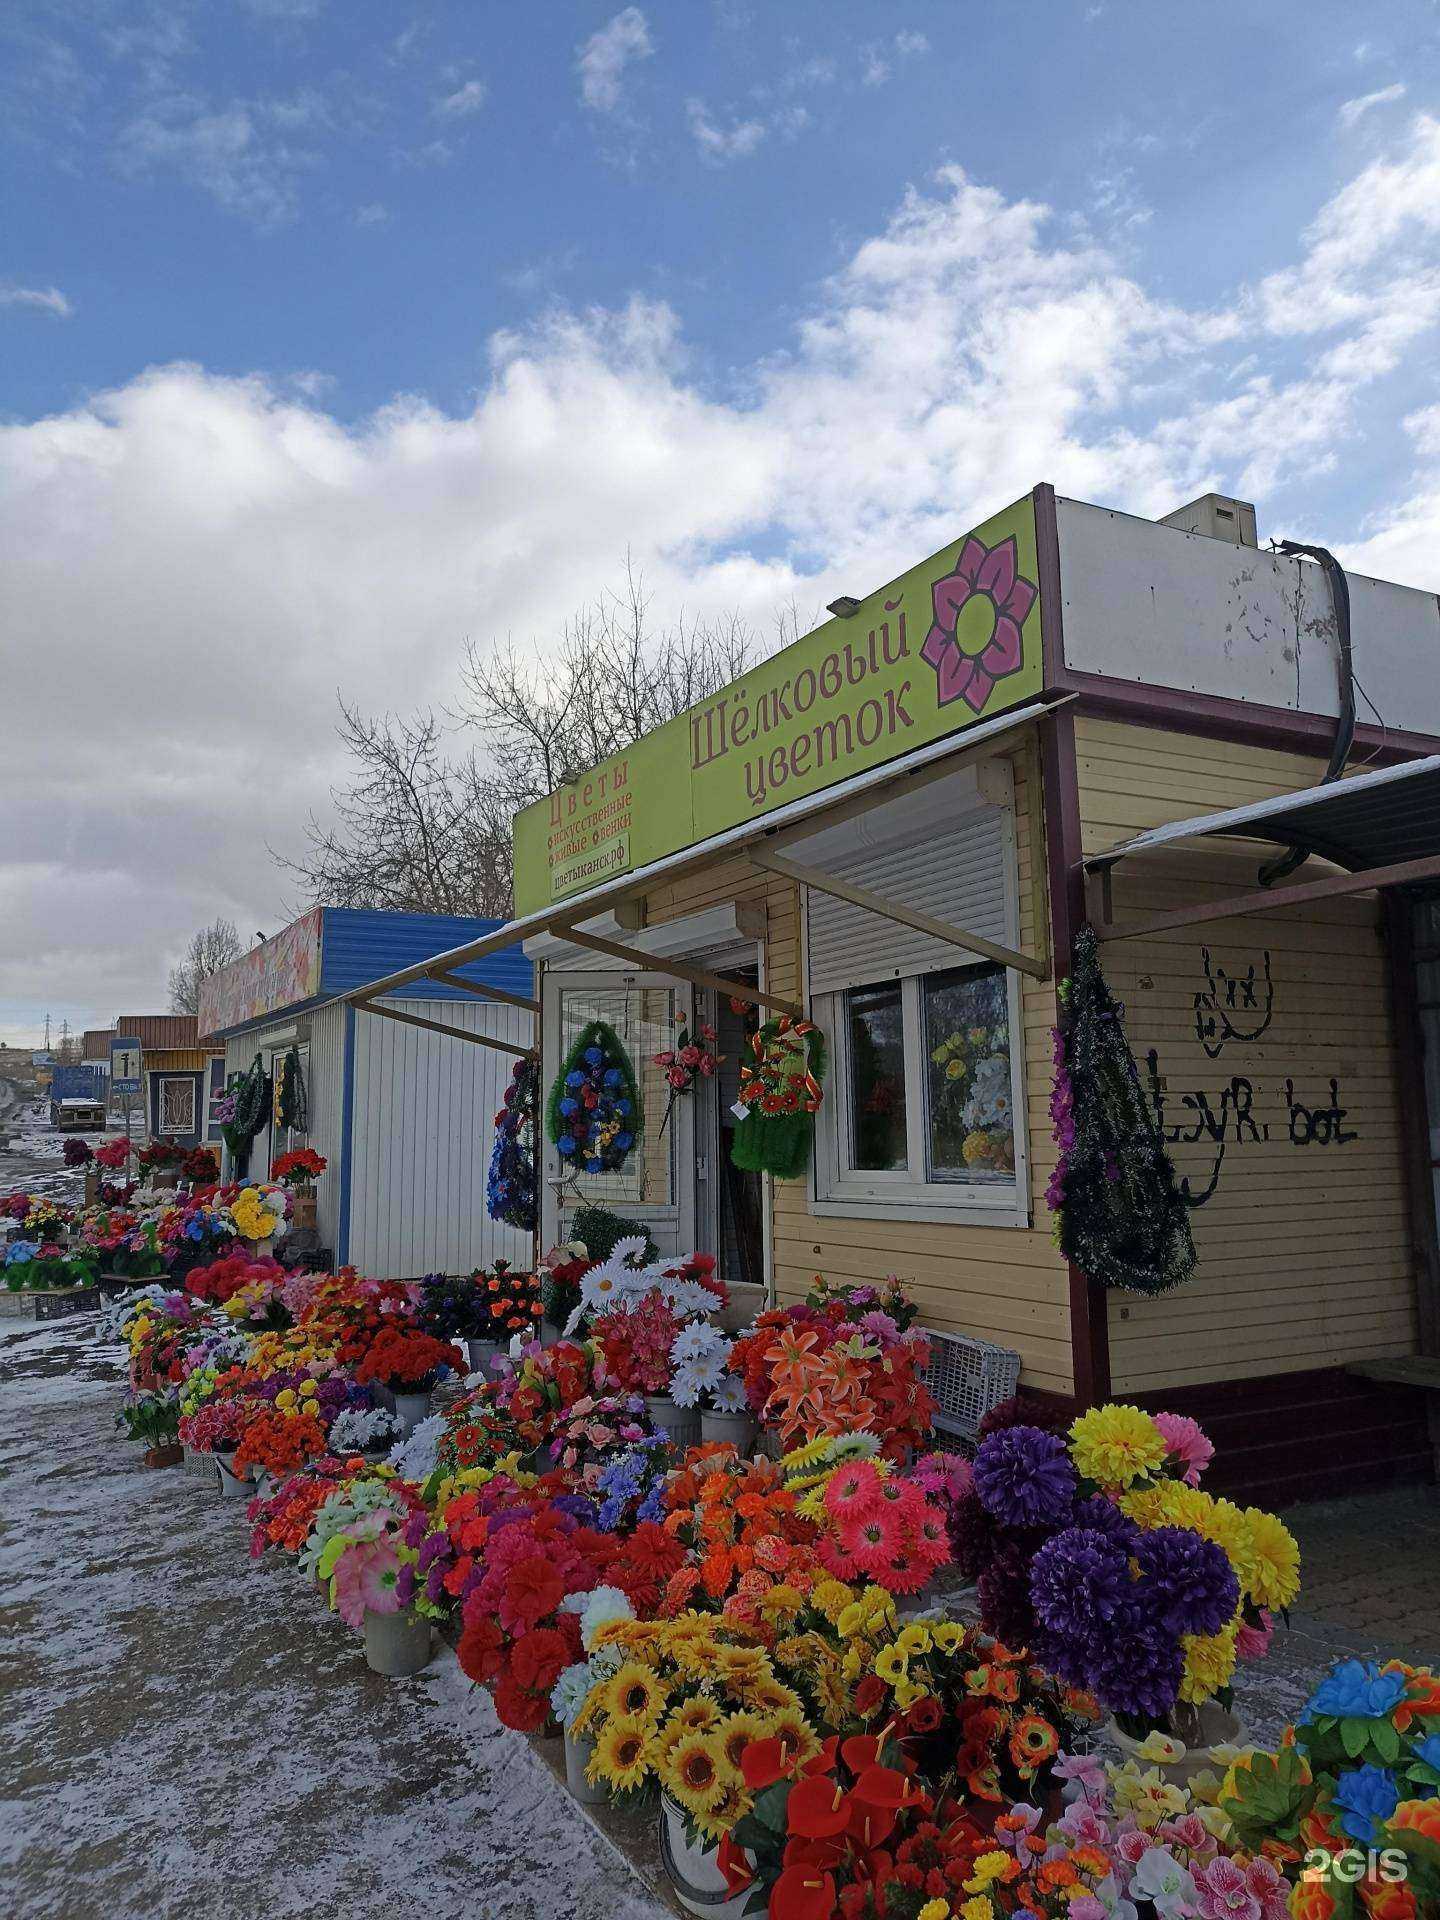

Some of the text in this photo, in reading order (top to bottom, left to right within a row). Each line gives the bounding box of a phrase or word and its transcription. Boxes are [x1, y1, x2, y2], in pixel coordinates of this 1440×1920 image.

[691, 593, 911, 770] Шёлковый
[744, 680, 914, 807] цветок
[550, 760, 629, 828] Цветы
[553, 792, 632, 844] искусственные
[554, 813, 632, 864] живые венки
[555, 839, 625, 890] цветыканск.рф
